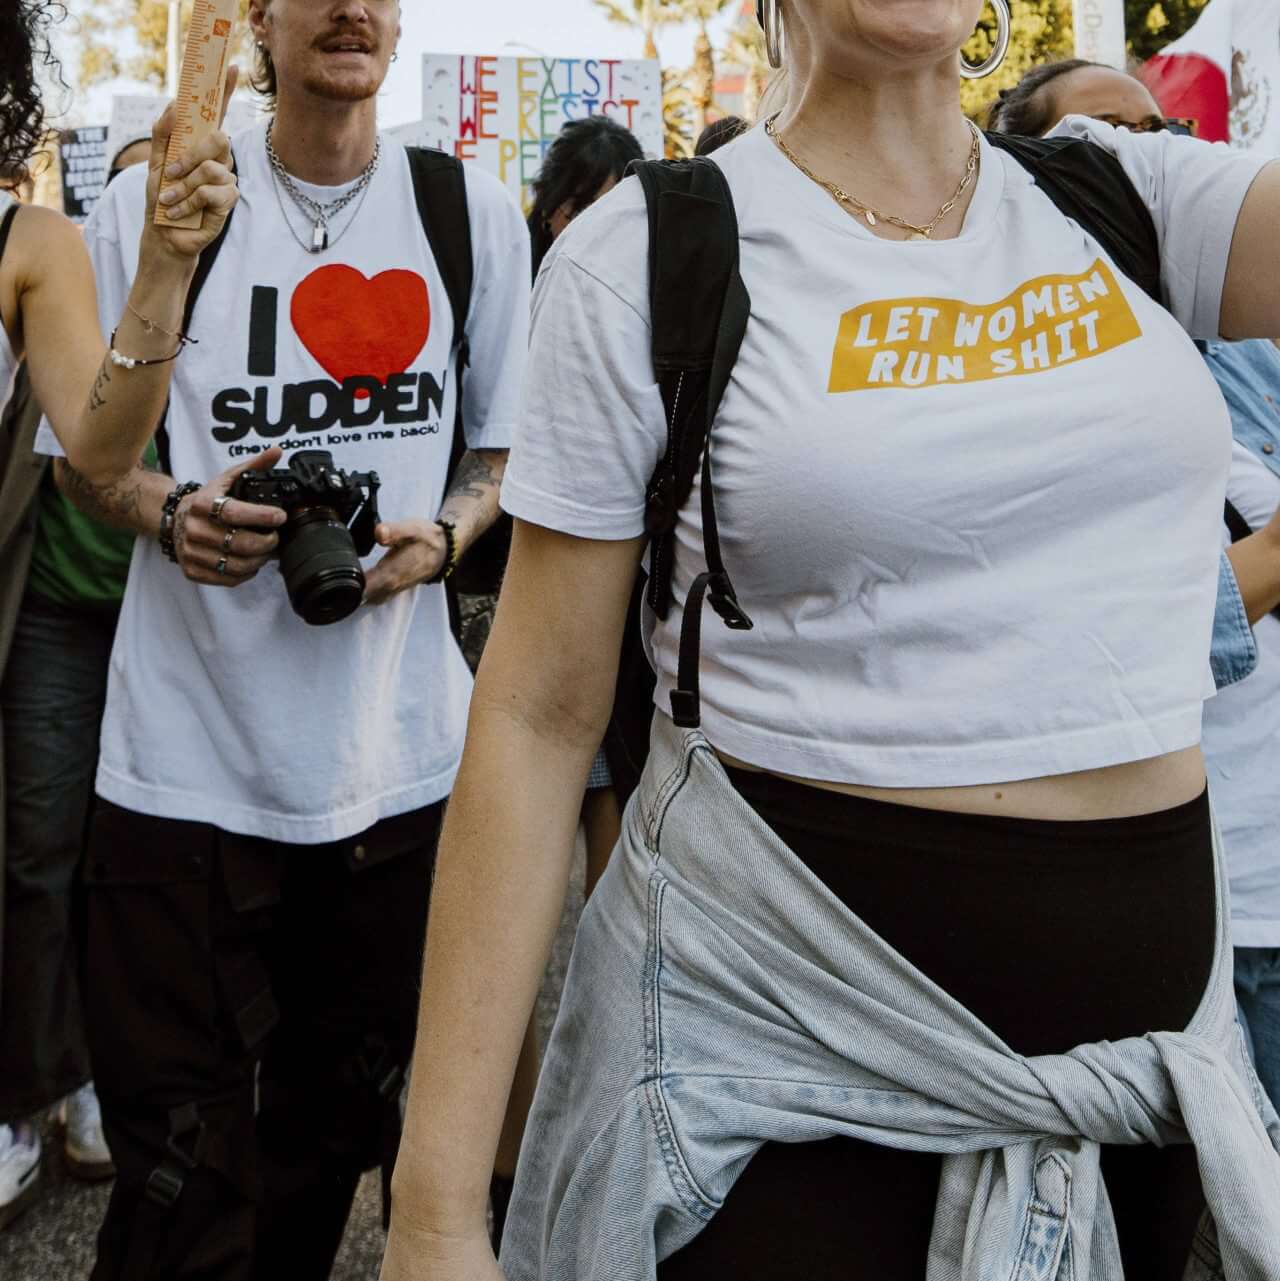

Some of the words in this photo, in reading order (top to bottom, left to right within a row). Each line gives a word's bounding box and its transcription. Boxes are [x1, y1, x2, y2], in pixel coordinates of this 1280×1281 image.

[459, 56, 498, 97] WE
[517, 57, 622, 99] EXIST
[459, 97, 498, 139] WE
[247, 285, 278, 376] I
[853, 306, 939, 348] LET
[954, 271, 1109, 347] WOMEN
[867, 351, 964, 386] RUN
[990, 312, 1099, 374] SHIT
[211, 370, 447, 443] SUDDEN
[278, 434, 322, 451] don't
[326, 431, 362, 445] love
[367, 428, 395, 441] me
[400, 423, 440, 438] back)
